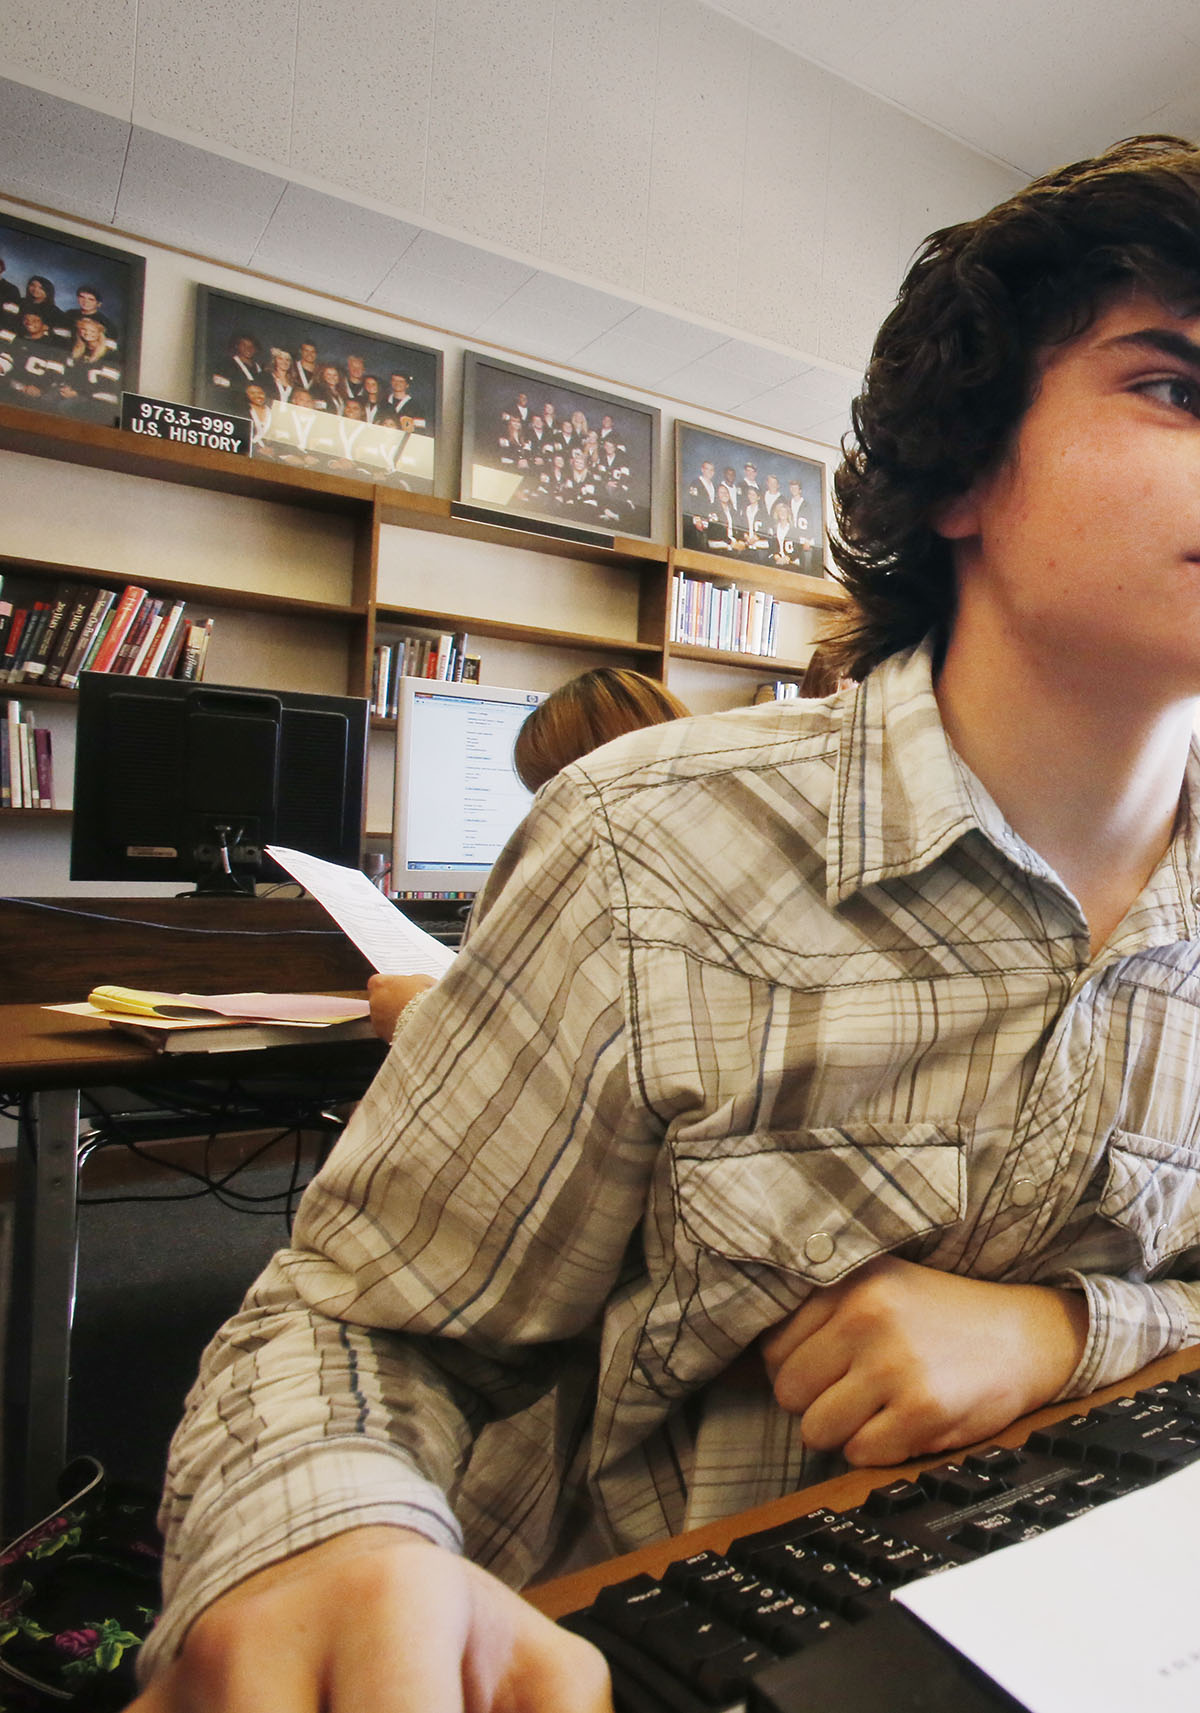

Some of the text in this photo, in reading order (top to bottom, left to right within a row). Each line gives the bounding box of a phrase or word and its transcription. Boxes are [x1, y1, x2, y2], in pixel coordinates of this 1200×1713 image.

[131, 418, 242, 453] U.S. HISTORY
[140, 403, 235, 436] 973.3-999
